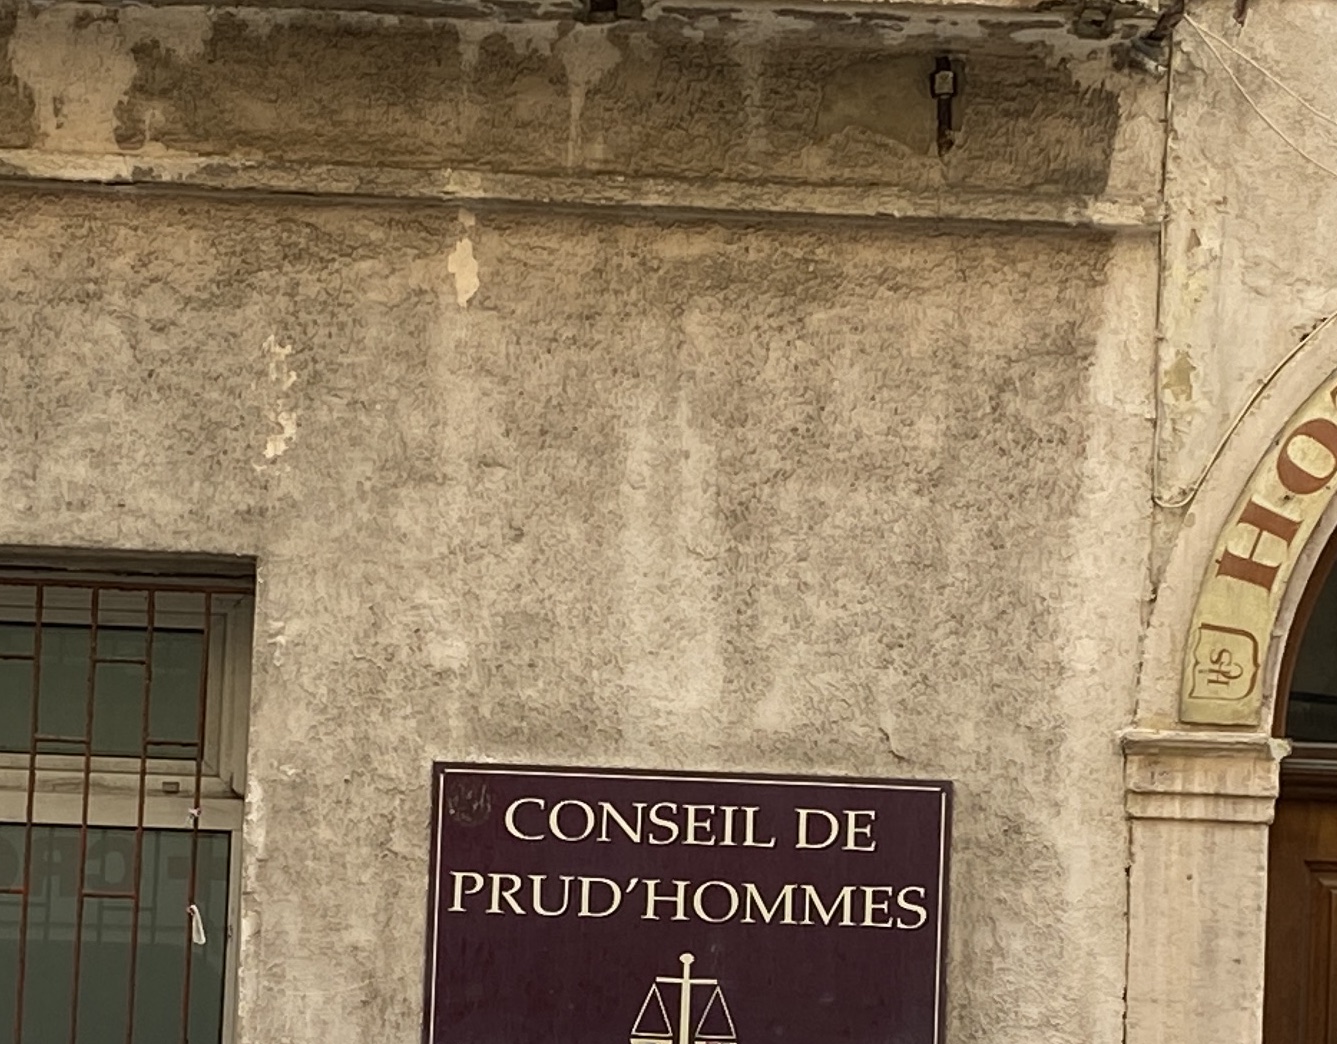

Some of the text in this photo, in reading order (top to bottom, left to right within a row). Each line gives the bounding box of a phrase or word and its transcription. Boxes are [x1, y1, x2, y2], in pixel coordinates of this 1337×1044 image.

[503, 797, 878, 852] CONSEIL DE
[447, 871, 929, 930] PRUD'HOMMES
